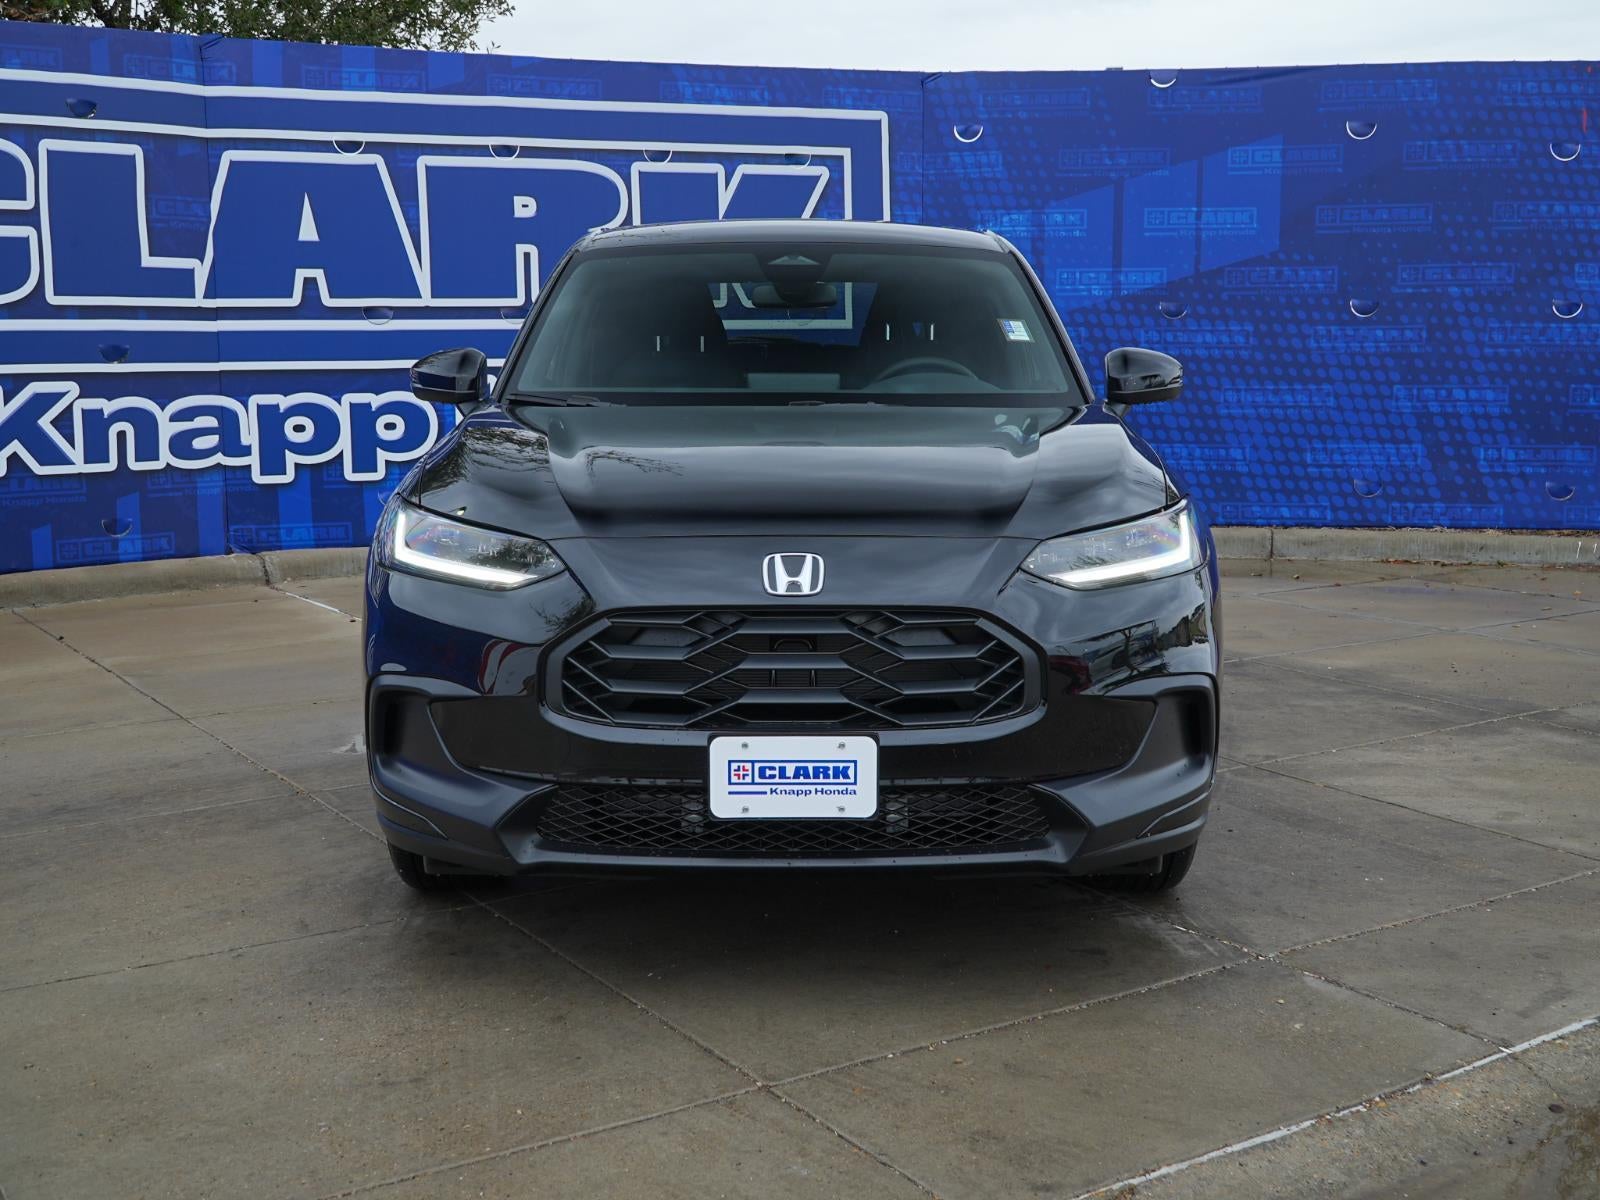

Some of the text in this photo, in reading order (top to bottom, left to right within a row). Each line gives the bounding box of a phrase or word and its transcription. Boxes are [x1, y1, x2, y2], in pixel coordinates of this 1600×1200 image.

[0, 380, 438, 484] Knapp
[758, 765, 851, 780] CLARK
[769, 787, 857, 797] Knapp Honda
